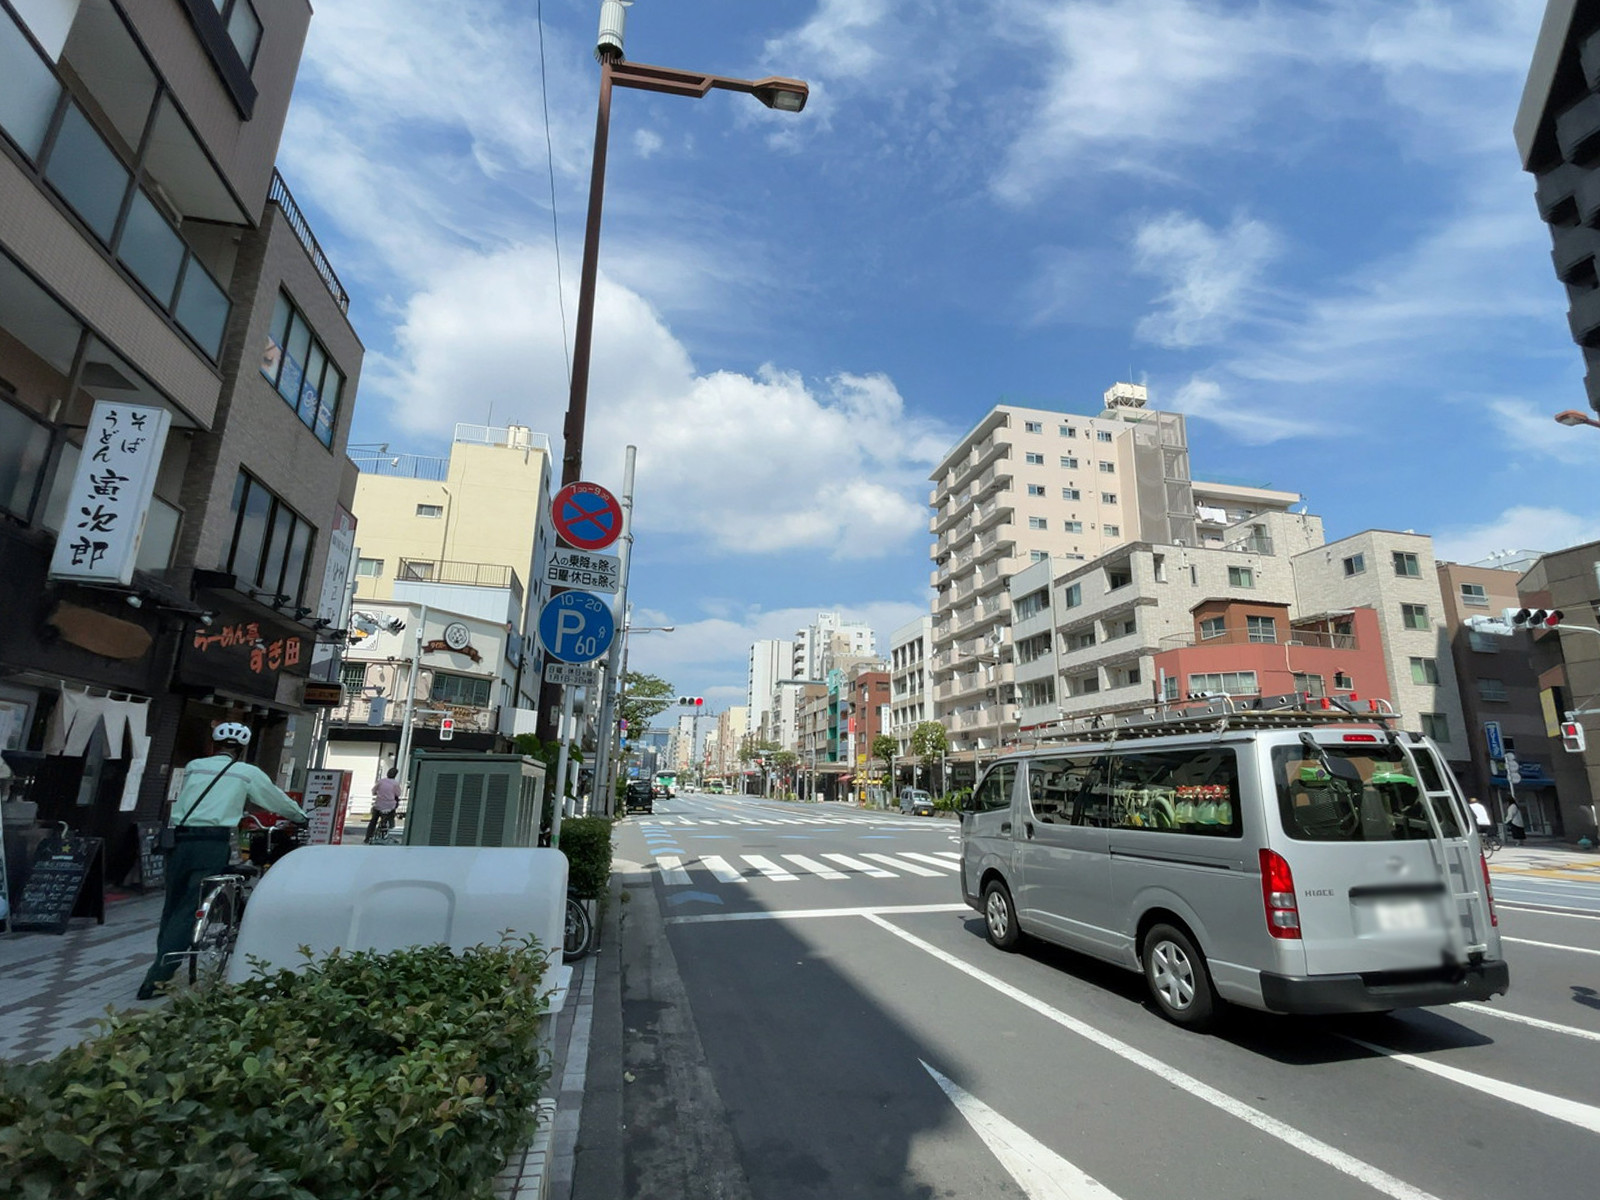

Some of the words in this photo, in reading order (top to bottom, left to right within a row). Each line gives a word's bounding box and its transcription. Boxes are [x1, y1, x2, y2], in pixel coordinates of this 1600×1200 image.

[92, 410, 119, 463] うどん
[121, 412, 147, 454] そば
[69, 468, 130, 570] 寅次郎
[548, 551, 617, 573] 人の乗降を除く
[193, 621, 260, 652] らーめん亭
[554, 608, 586, 654] P
[249, 637, 301, 674] すぎ田
[1304, 889, 1335, 897] HIACE
